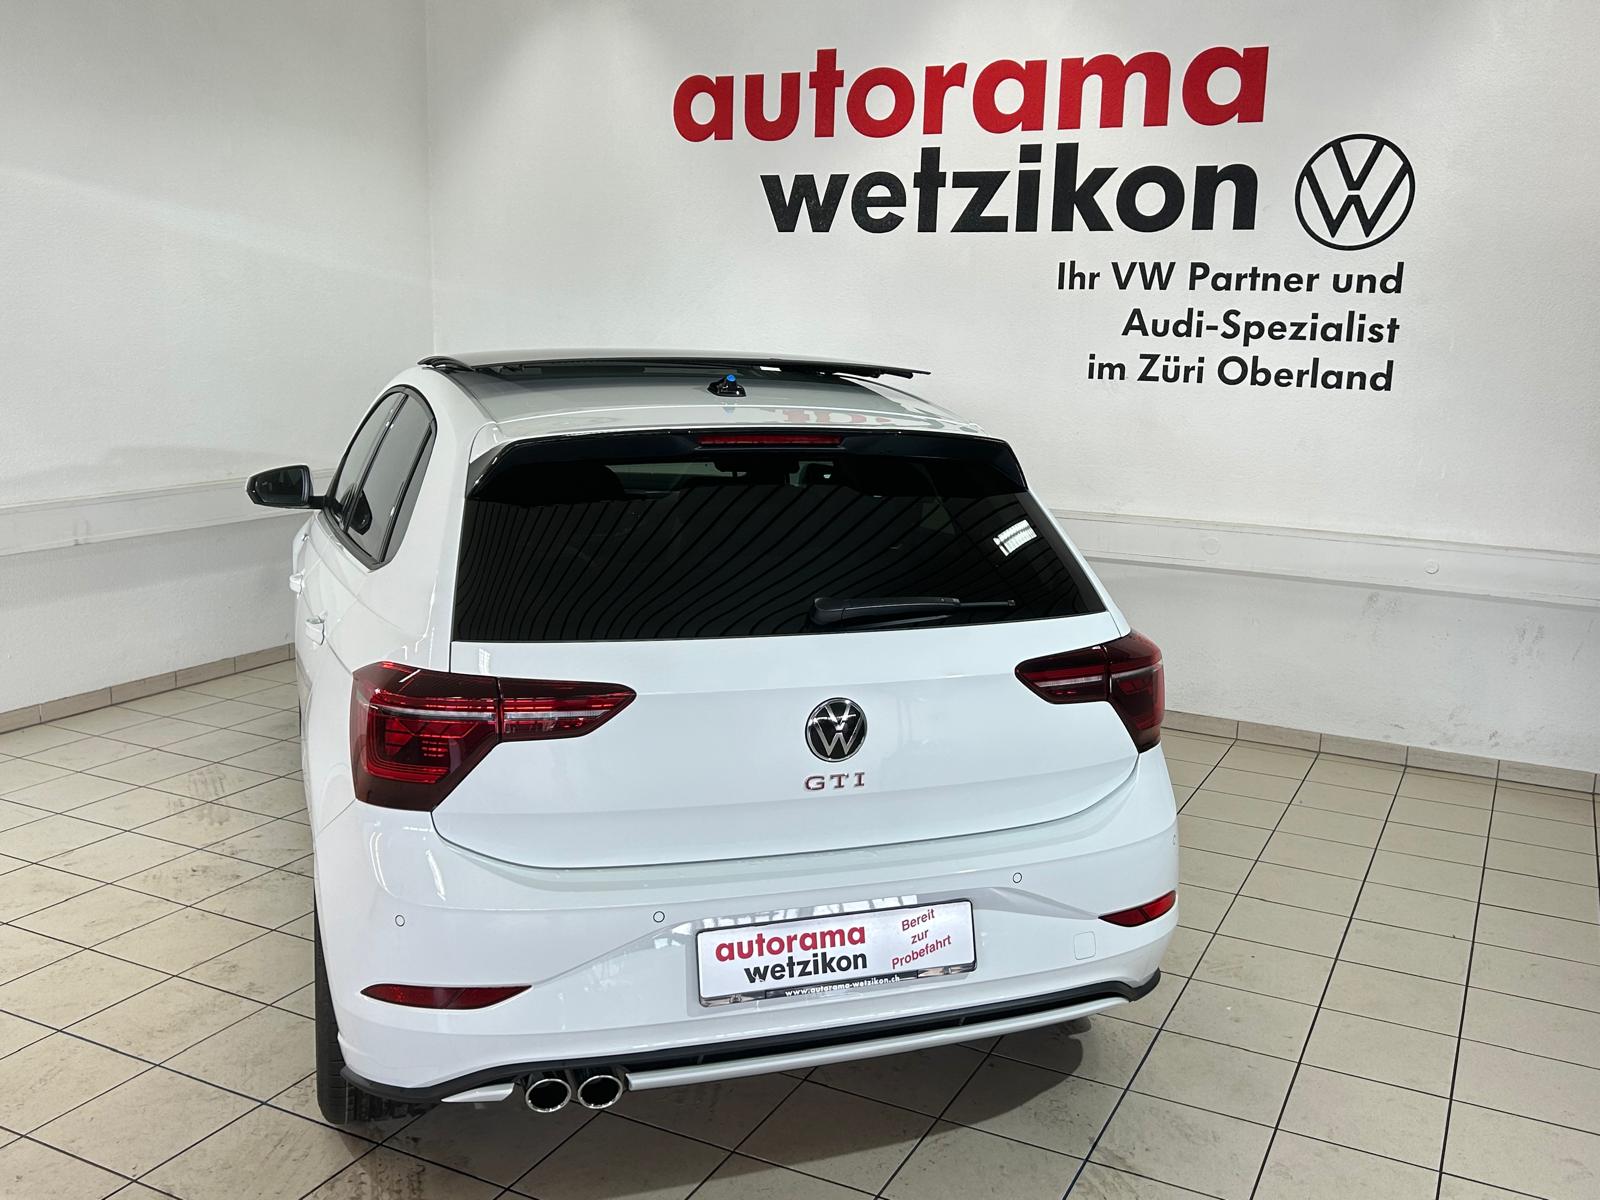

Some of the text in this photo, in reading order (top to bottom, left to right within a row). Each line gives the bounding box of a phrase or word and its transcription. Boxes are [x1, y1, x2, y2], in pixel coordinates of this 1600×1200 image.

[673, 46, 1269, 142] autorama
[760, 142, 1258, 234] wetzikon
[1057, 261, 1405, 295] Ihr VW Partner und
[1121, 307, 1401, 346] Audi-Spezialist
[1088, 353, 1395, 392] im Züri Oberland
[805, 772, 865, 790] GTI
[902, 908, 935, 932] Bereit
[911, 928, 929, 944] zur
[715, 926, 866, 962] autorama
[892, 935, 952, 970] Probefahrt
[744, 952, 867, 984] wetzikon
[784, 975, 901, 997] www.autorama-wetzikon.ch
